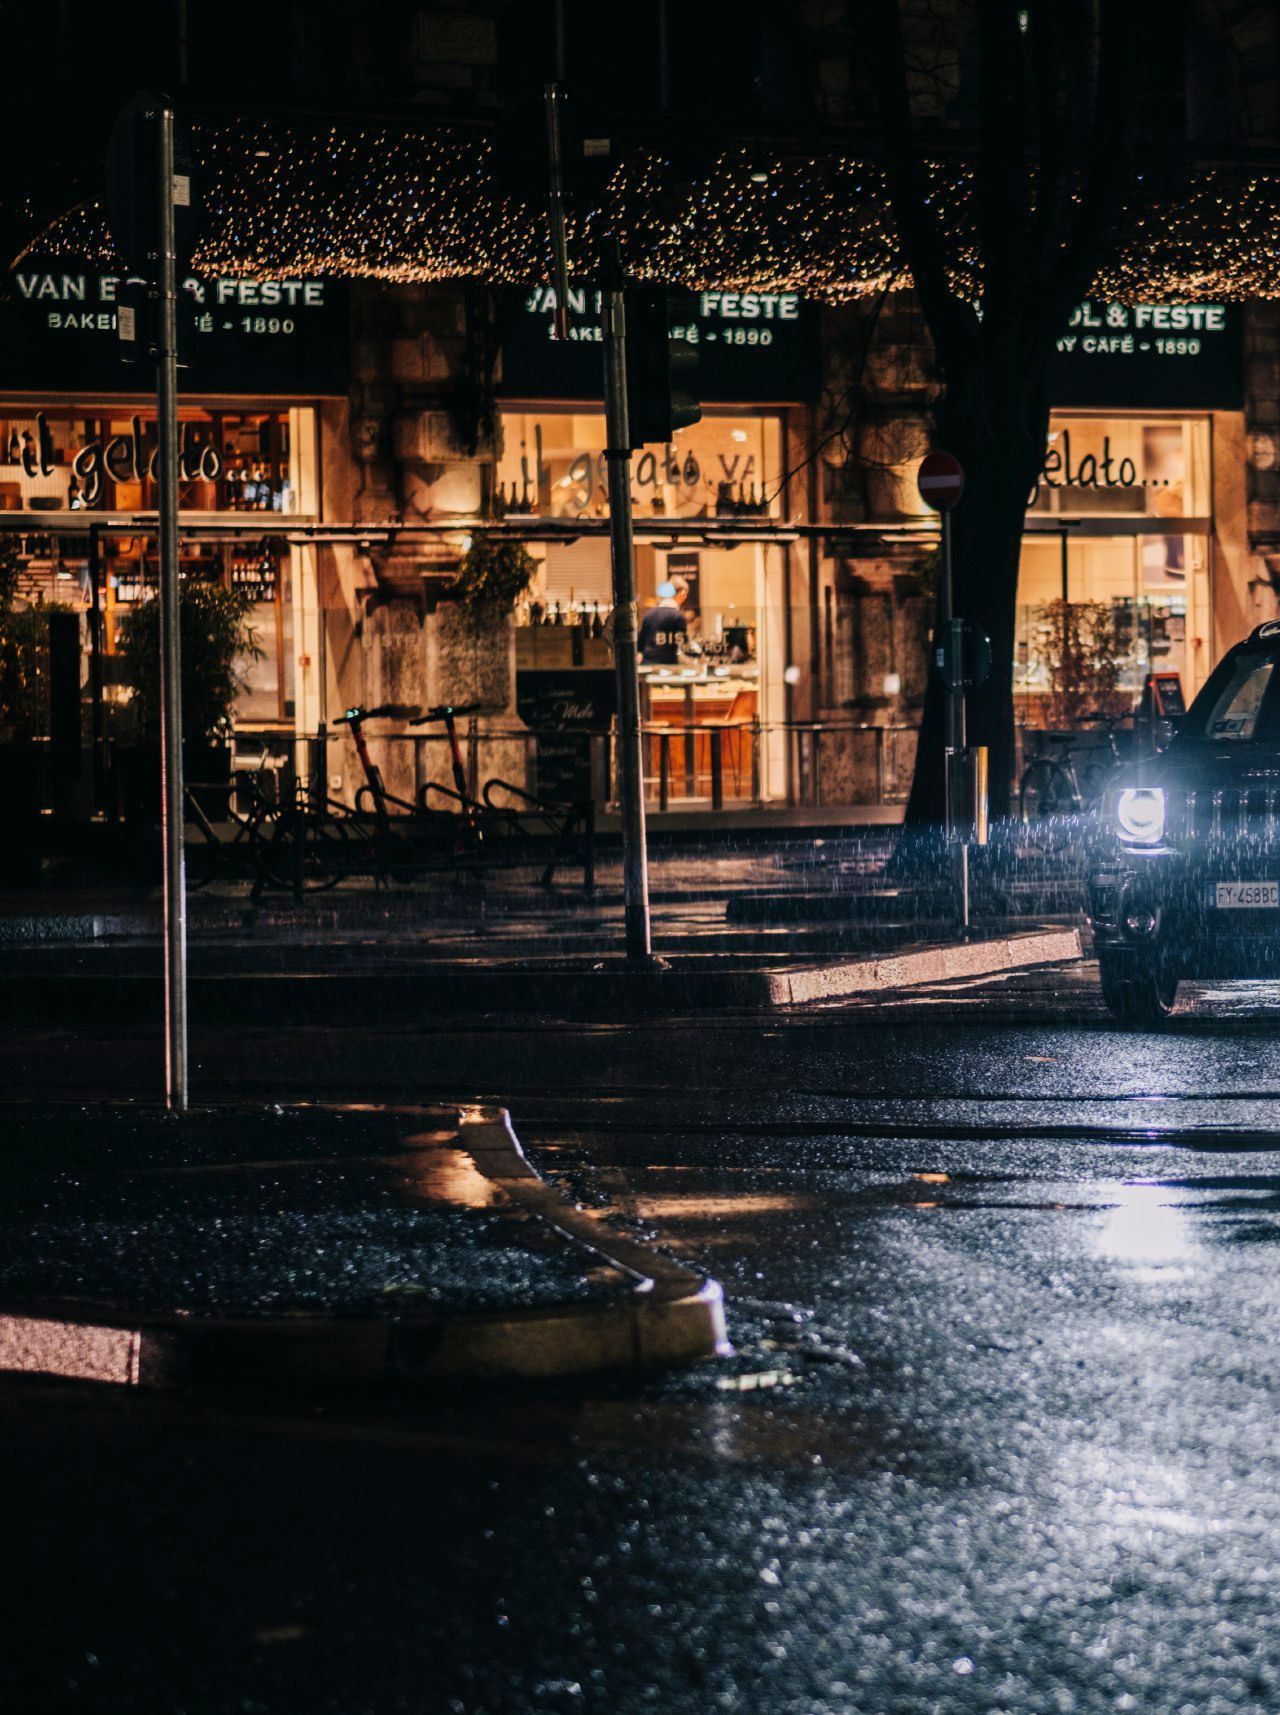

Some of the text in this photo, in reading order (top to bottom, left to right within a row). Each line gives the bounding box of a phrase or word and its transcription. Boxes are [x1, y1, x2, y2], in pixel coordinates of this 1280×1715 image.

[16, 273, 86, 301] VAN
[216, 278, 325, 307] FESTE
[700, 291, 799, 320] FESTE
[1105, 302, 1129, 328] &
[1134, 304, 1226, 331] FESTE
[240, 315, 296, 335] 1890
[722, 326, 774, 347] 1890
[1081, 333, 1135, 354] CAFÉ
[1154, 337, 1201, 356] 1890
